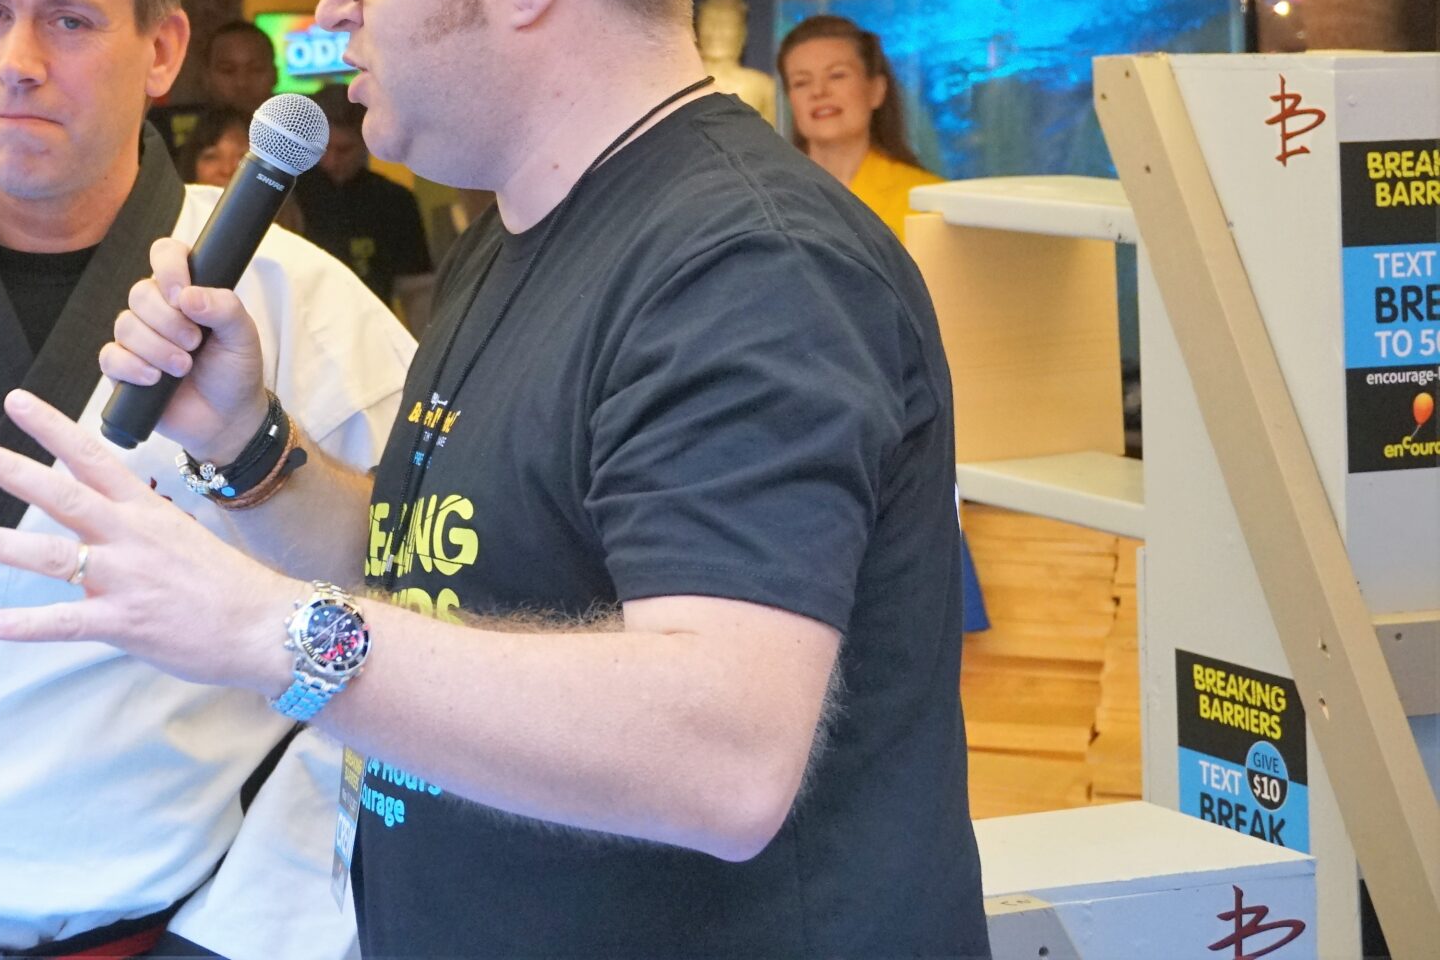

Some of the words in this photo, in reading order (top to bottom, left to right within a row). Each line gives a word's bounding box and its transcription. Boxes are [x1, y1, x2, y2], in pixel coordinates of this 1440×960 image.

[256, 173, 285, 192] SHURE
[1374, 251, 1437, 279] TEXT
[1375, 331, 1412, 359] TO
[1193, 664, 1287, 713] BREAKING
[1199, 694, 1282, 740] BARRIERS
[1199, 760, 1242, 796] TEXT
[1253, 752, 1280, 774] GIVE
[1253, 773, 1281, 803] $10
[362, 782, 406, 828] ourage
[1200, 791, 1286, 847] BREAK
